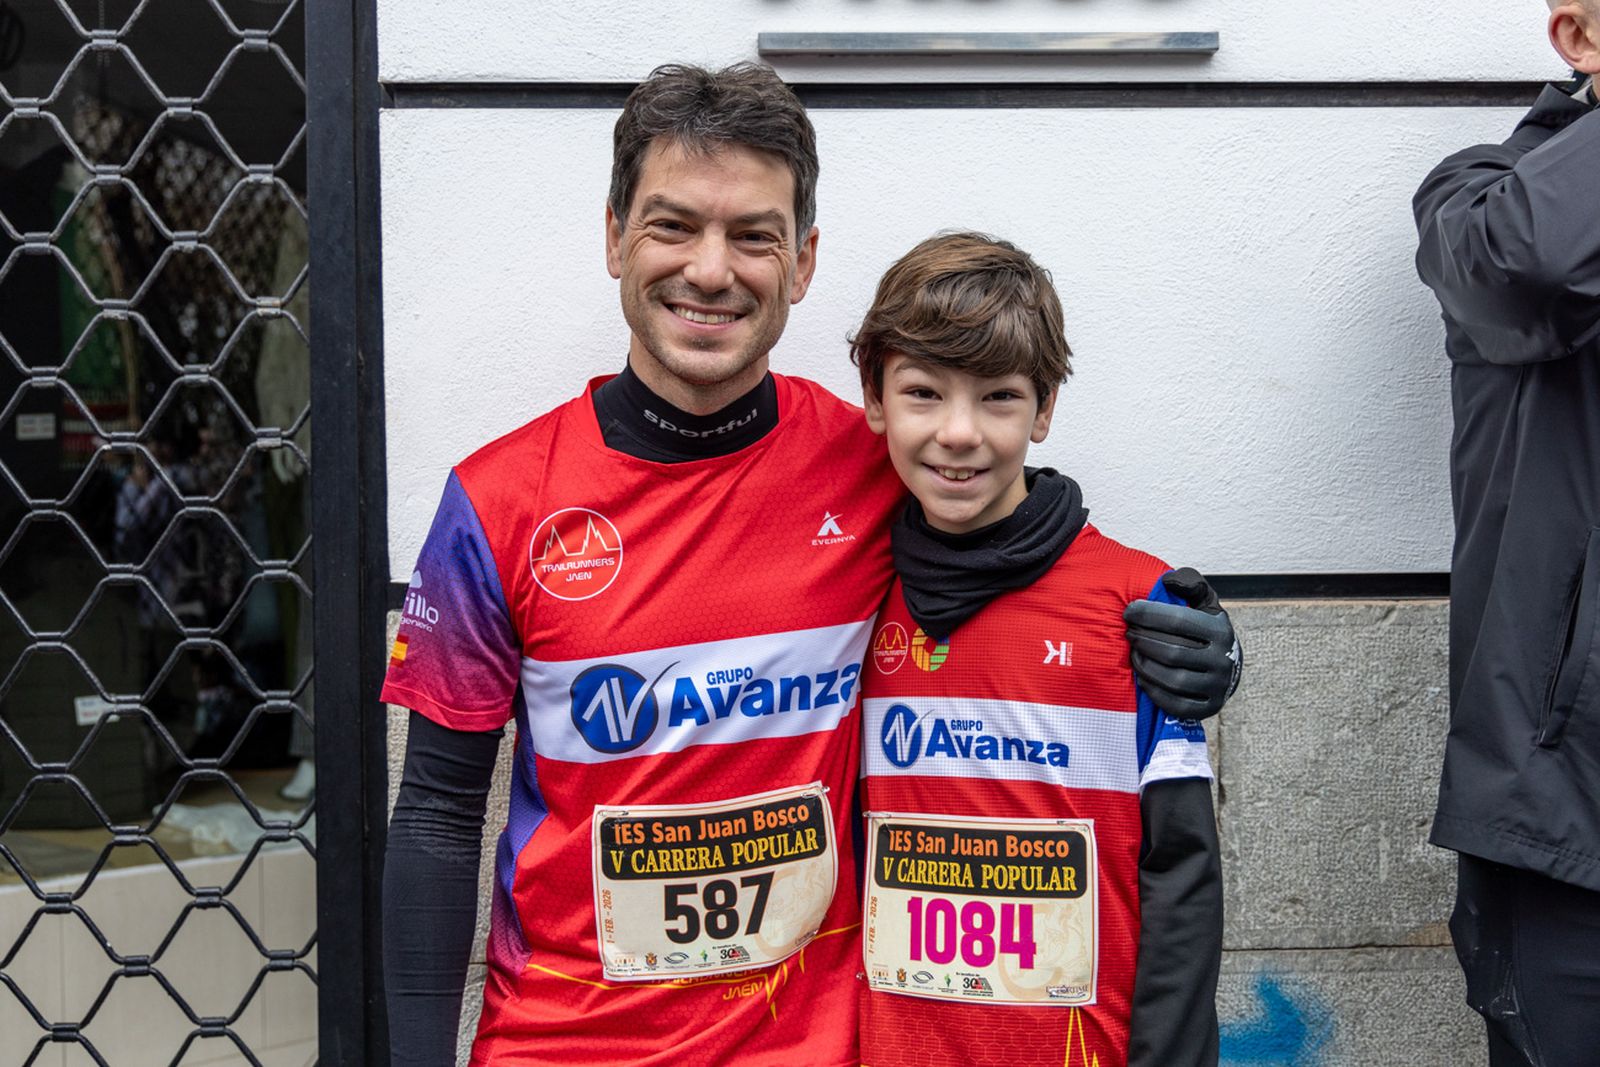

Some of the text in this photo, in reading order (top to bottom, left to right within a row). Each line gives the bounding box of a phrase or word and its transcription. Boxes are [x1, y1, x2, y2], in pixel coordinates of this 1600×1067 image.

[643, 408, 758, 437] sportful
[811, 535, 856, 546] EVERNYA
[541, 557, 615, 573] TRAILRUNNERS
[406, 592, 439, 624] illo
[707, 667, 753, 685] GRUPO
[668, 663, 861, 727] Avanza
[951, 719, 983, 731] GRUPO
[925, 718, 1070, 768] Avanza
[614, 804, 810, 845] IES San Juan Bosco
[610, 828, 819, 874] V CARRERA POPULAR
[889, 830, 1070, 858] IES San Juan Bosco
[883, 857, 1077, 891] V CARRERA POPULAR
[602, 889, 612, 910] 2026
[664, 871, 775, 944] 587
[907, 896, 1037, 970] 1084
